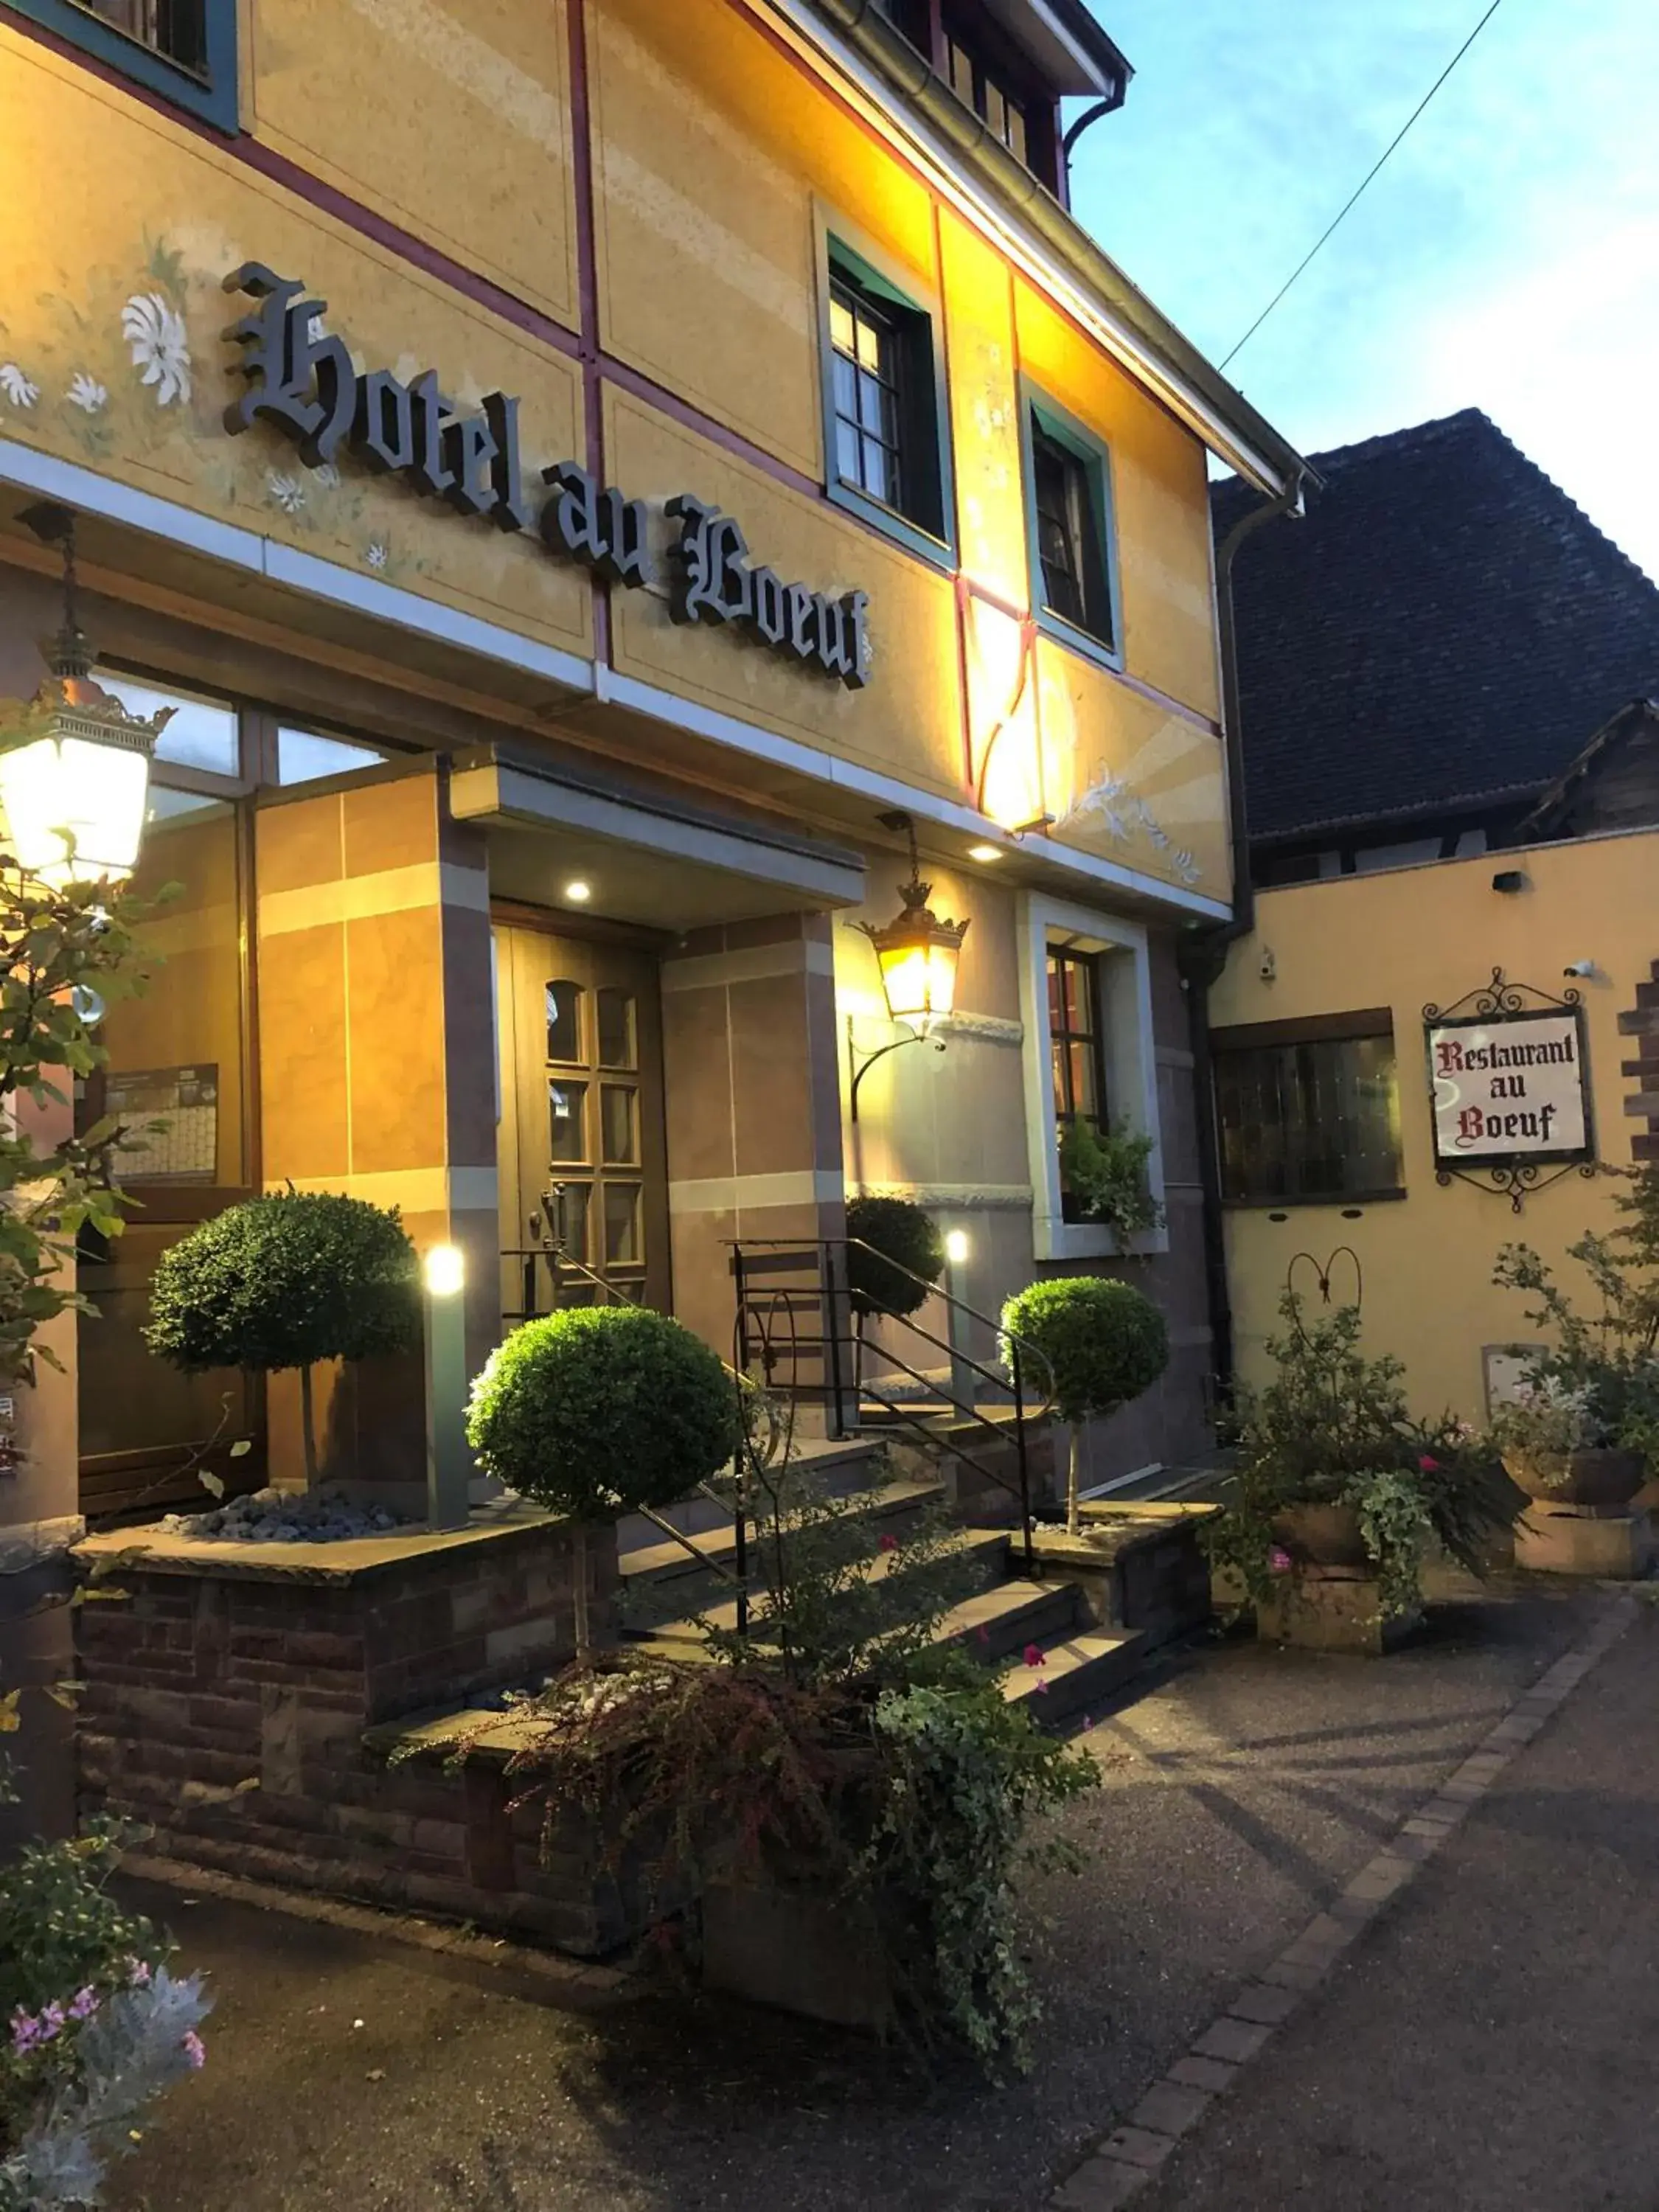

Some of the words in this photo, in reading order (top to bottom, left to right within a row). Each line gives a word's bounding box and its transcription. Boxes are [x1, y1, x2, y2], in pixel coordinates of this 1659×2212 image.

[222, 260, 532, 532] Hotel
[541, 461, 657, 588] au
[665, 494, 871, 690] Boeuf
[1436, 1034, 1575, 1079] Restaurant
[1490, 1074, 1526, 1099] au
[1455, 1103, 1557, 1148] Boeuf
